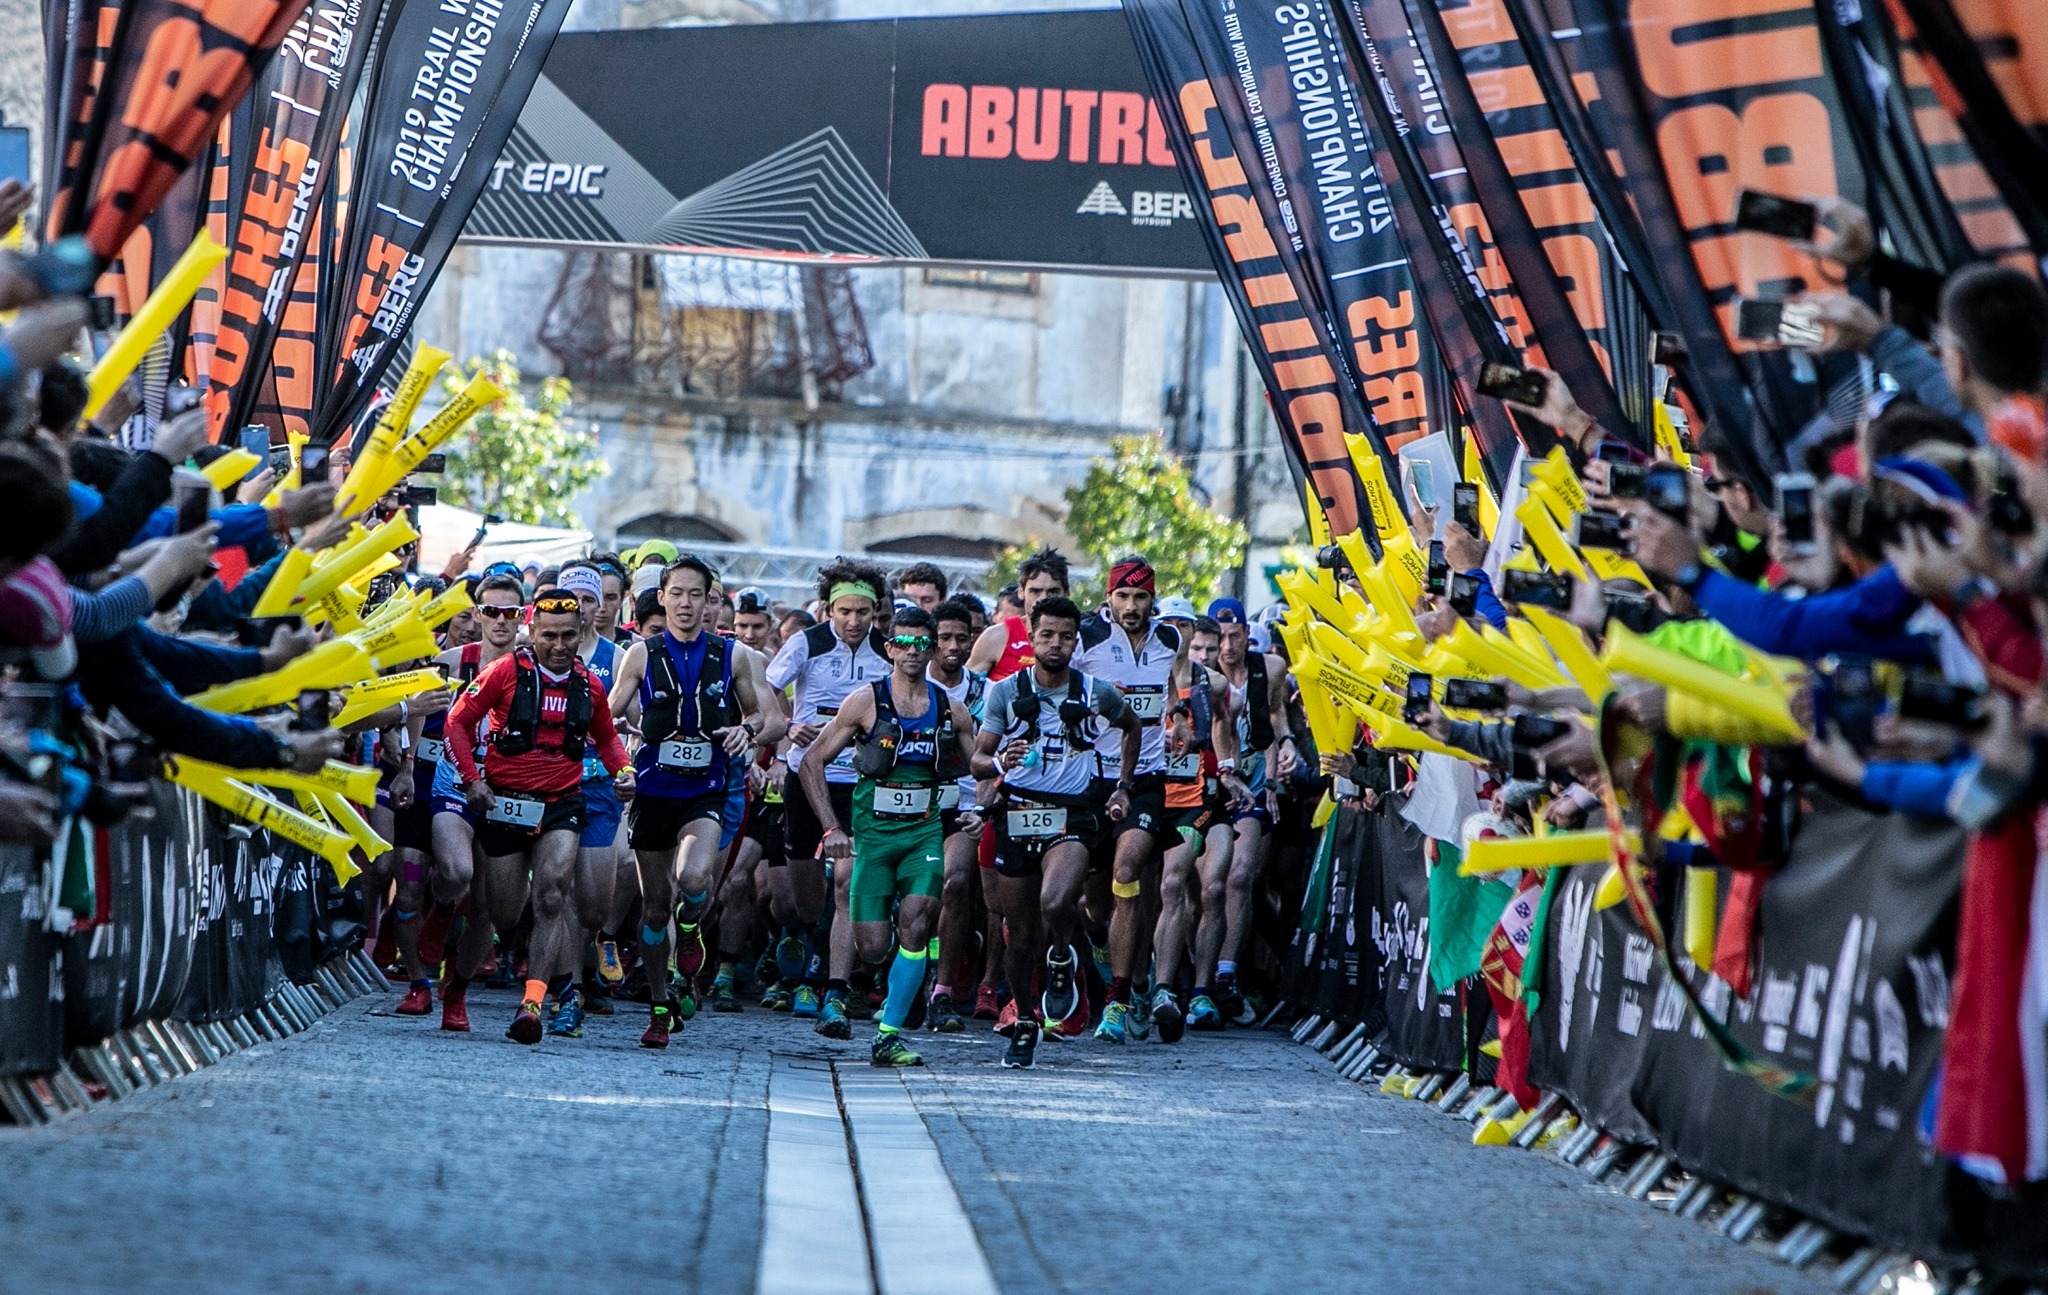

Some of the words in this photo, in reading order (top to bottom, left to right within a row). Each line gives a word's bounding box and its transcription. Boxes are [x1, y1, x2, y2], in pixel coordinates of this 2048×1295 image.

[390, 107, 426, 182] 2019
[411, 26, 460, 102] TRAIL
[522, 162, 605, 195] EPIC
[1131, 217, 1172, 226] OUTDOOR
[372, 254, 425, 336] BERG
[391, 301, 415, 340] OUTDOOR
[1367, 480, 1380, 510] FILHOS
[1319, 669, 1352, 690] FILHOS
[672, 745, 702, 760] 282
[503, 801, 523, 817] 81
[893, 792, 914, 807] 91
[1021, 813, 1053, 828] 126
